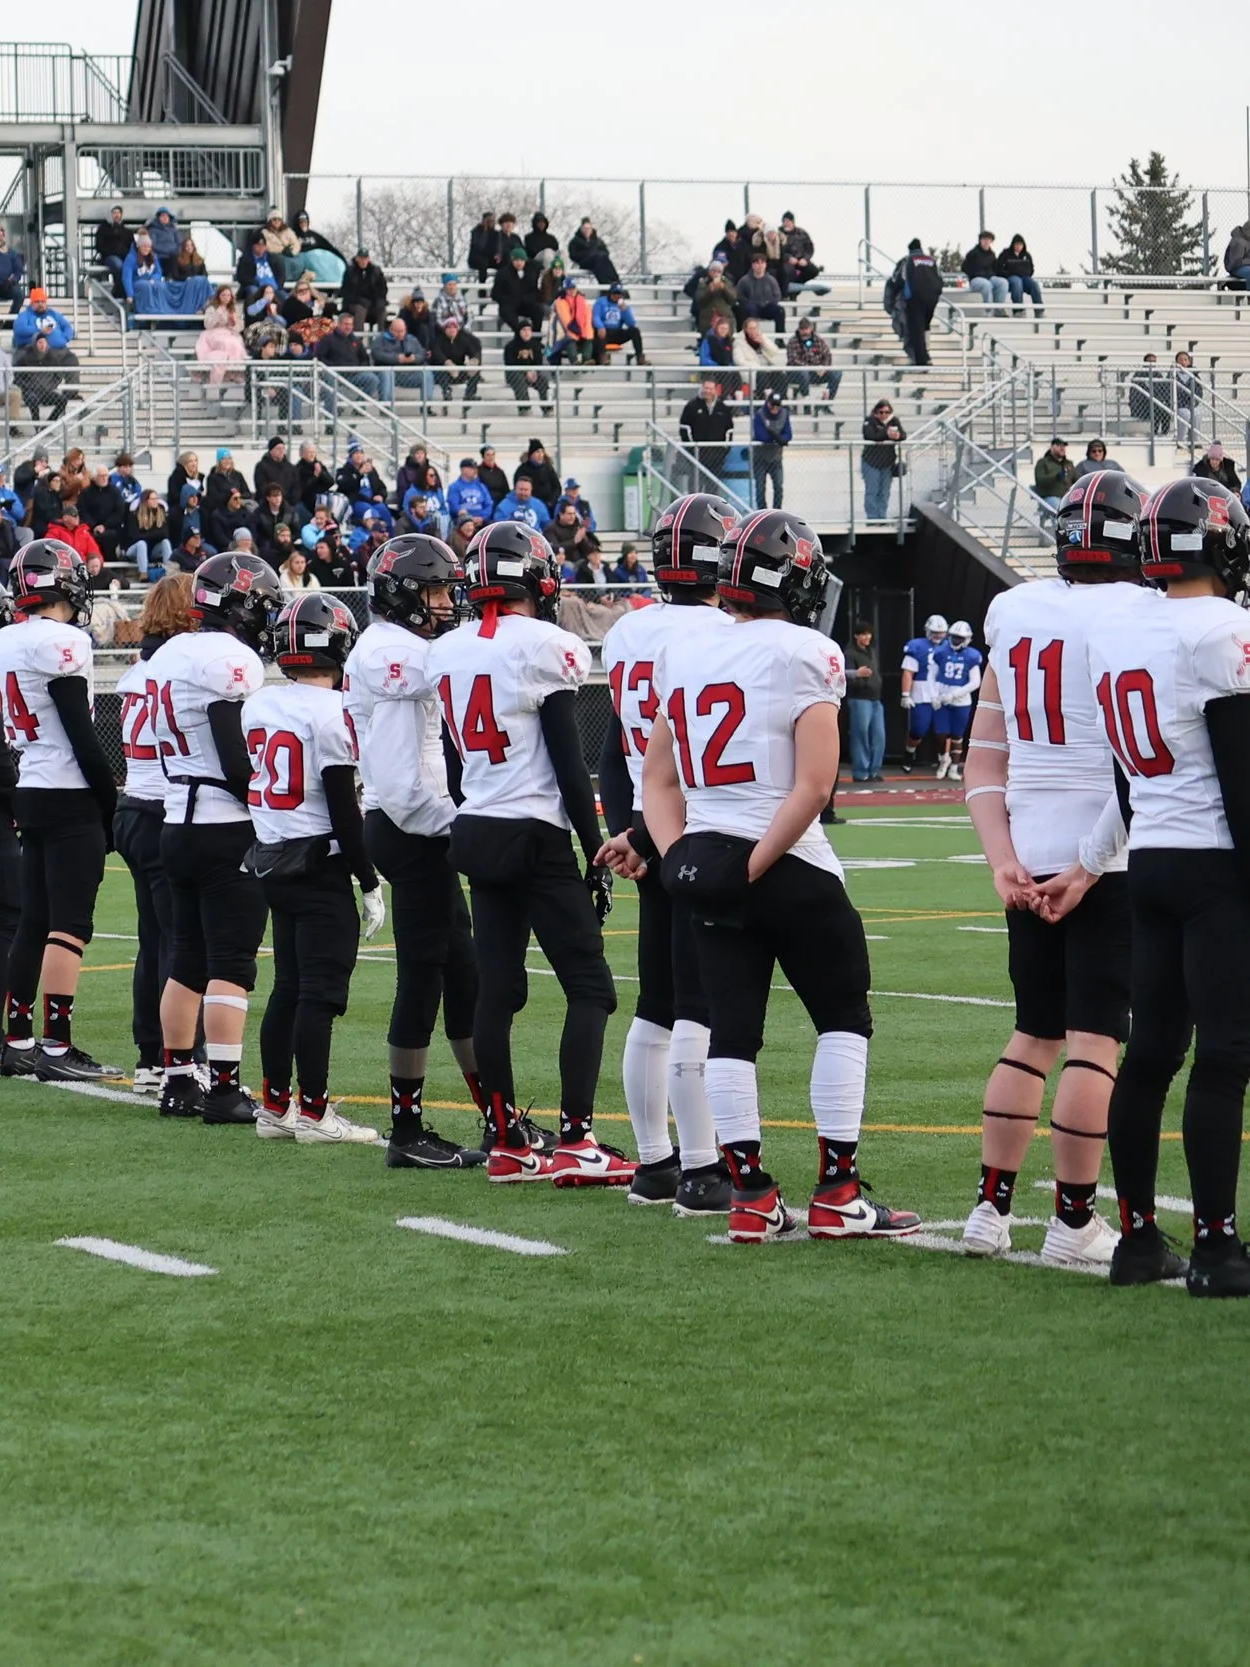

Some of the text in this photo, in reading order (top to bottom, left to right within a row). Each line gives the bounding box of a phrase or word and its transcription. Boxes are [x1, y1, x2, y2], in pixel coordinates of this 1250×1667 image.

[1207, 495, 1230, 528] S
[57, 549, 72, 569] S
[530, 536, 546, 560] S
[793, 537, 812, 570] S
[377, 549, 398, 576] S
[231, 568, 254, 594] S
[334, 607, 349, 631] S
[63, 650, 73, 662] S
[565, 652, 575, 667] S
[829, 656, 840, 673] S
[233, 668, 243, 682] S
[390, 664, 400, 678] S
[1009, 636, 1066, 746] 11
[437, 674, 512, 765] 14
[609, 661, 660, 757] 13
[667, 681, 757, 789] 12
[1096, 668, 1176, 779] 10
[247, 728, 304, 811] 20
